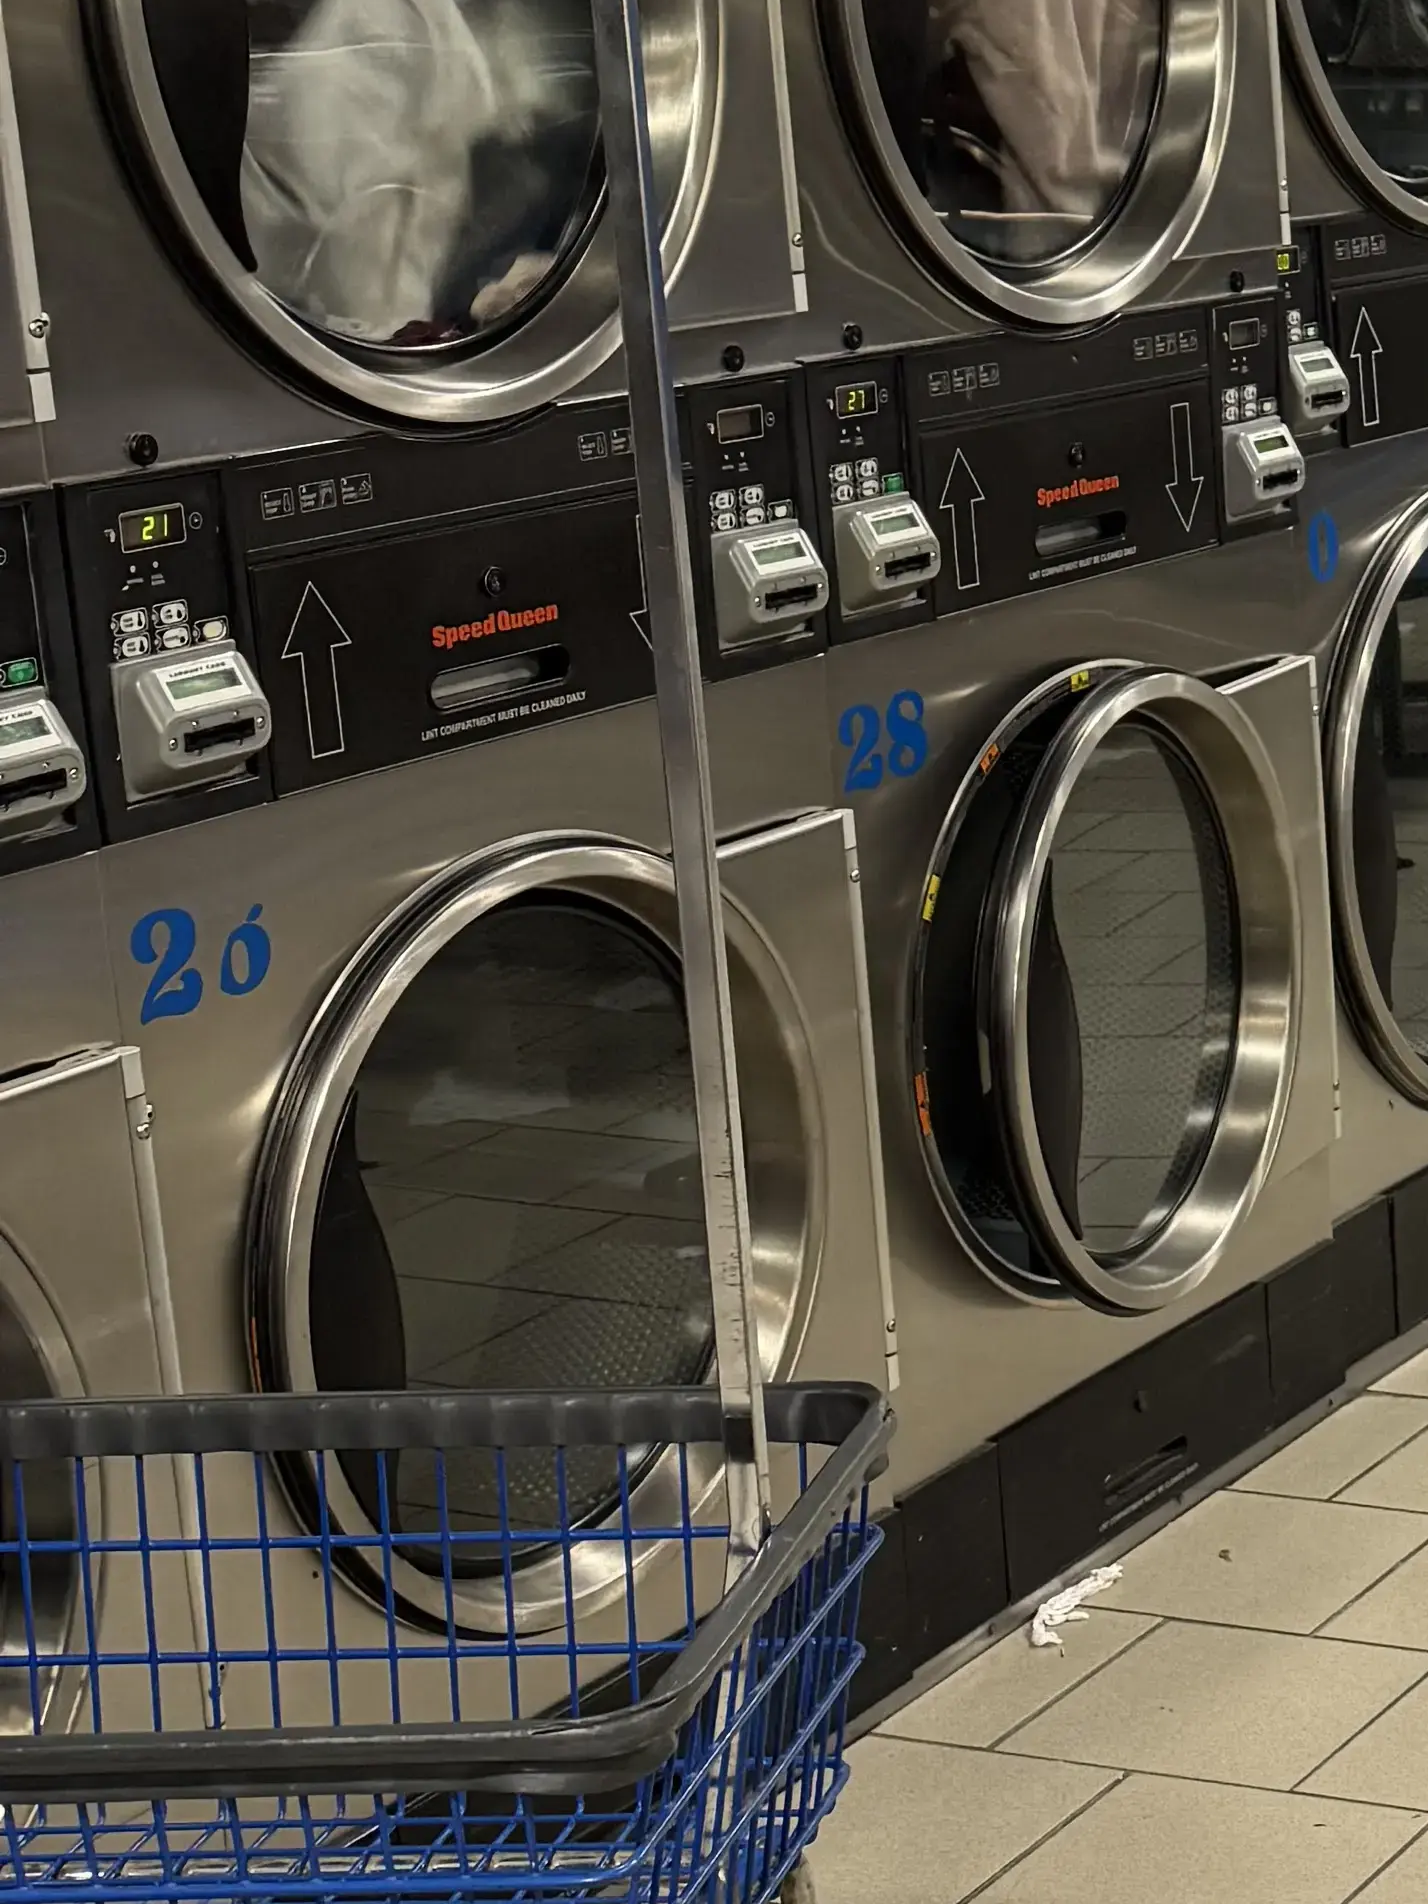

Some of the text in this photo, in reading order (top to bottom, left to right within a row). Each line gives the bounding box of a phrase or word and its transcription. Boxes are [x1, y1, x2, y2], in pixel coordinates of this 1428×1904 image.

[848, 390, 865, 411] 27
[1037, 475, 1119, 508] Speed Queen
[142, 513, 168, 541] 21
[432, 604, 559, 650] Speed Queen
[838, 689, 928, 794] 28
